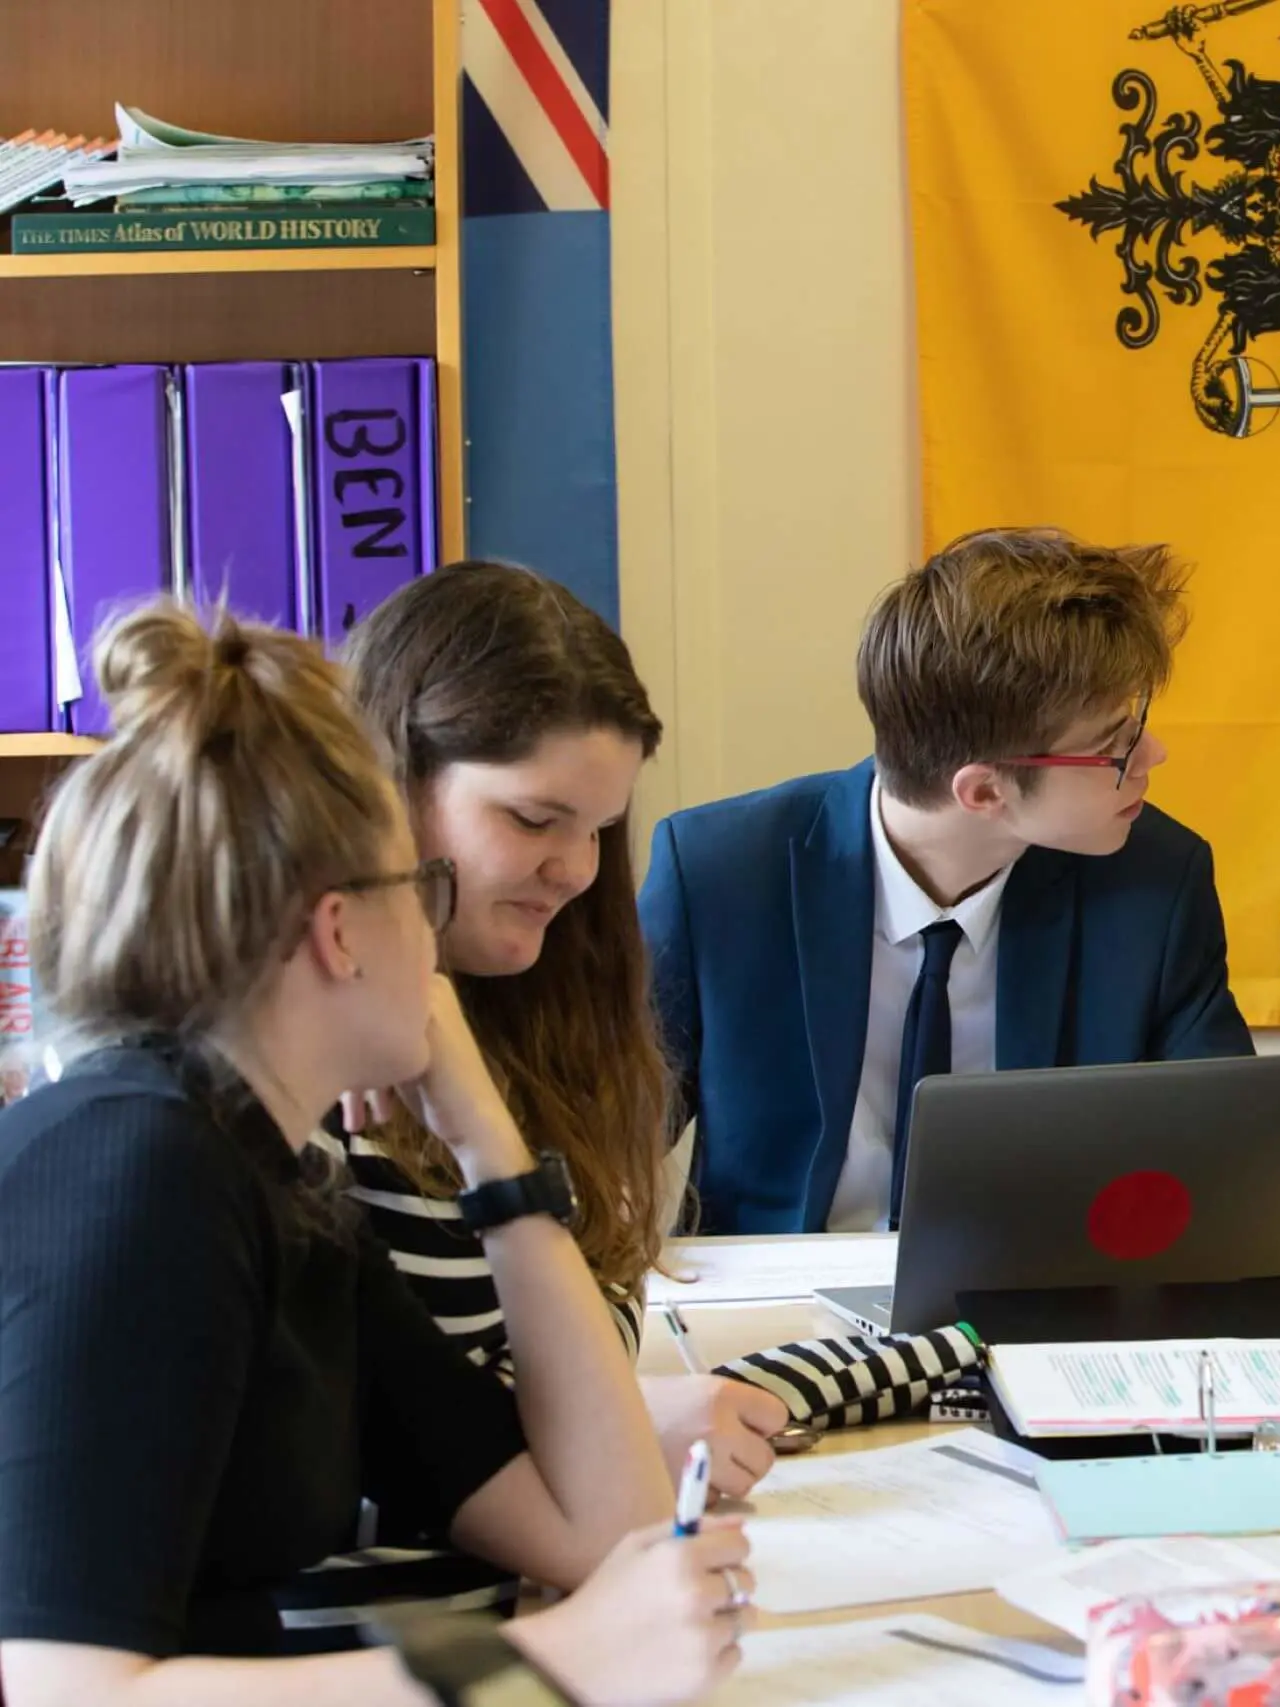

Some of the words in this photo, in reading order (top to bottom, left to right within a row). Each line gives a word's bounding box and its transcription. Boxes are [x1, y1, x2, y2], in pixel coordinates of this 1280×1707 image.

[19, 229, 55, 244] THE
[58, 227, 111, 244] TIMES
[114, 222, 162, 242] Atlas
[164, 221, 187, 242] of
[190, 219, 277, 242] WORLD
[279, 217, 382, 240] HISTORY
[325, 409, 407, 558] BEN
